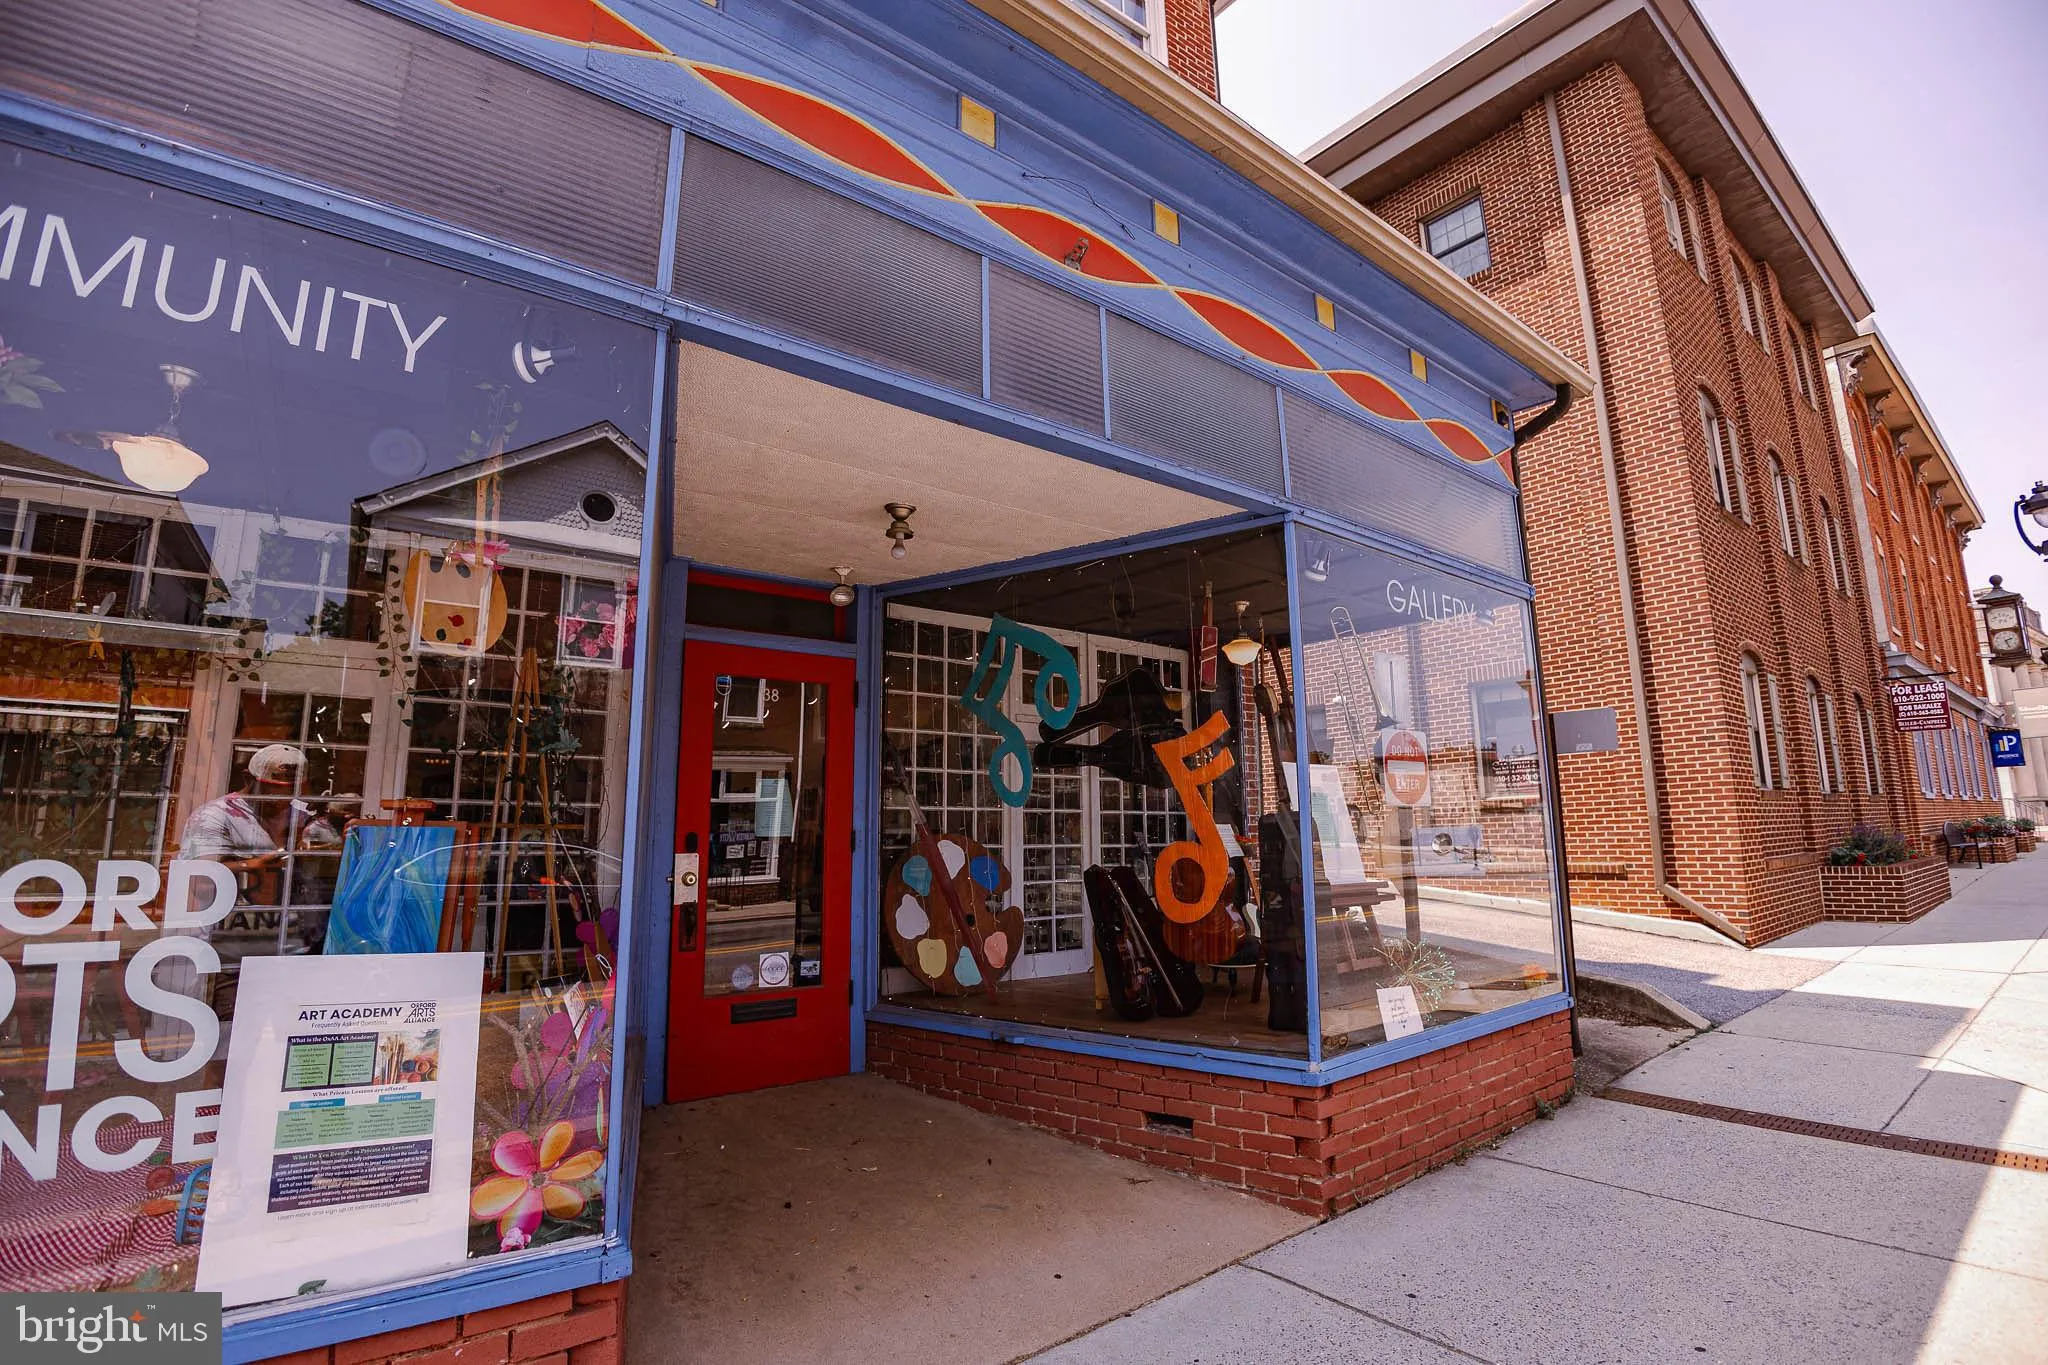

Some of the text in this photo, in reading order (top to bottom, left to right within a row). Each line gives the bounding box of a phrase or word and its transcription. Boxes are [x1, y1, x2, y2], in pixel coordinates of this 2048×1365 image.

[0, 205, 447, 373] MUNITY
[1891, 682, 1945, 696] FOR LEASE
[1893, 692, 1946, 703] 610-932-1000
[1391, 745, 1402, 756] DO
[0, 935, 222, 1092] TS
[298, 1007, 403, 1021] ART ACADEMY
[407, 1008, 436, 1018] ARTS
[0, 1089, 222, 1181] NCE
